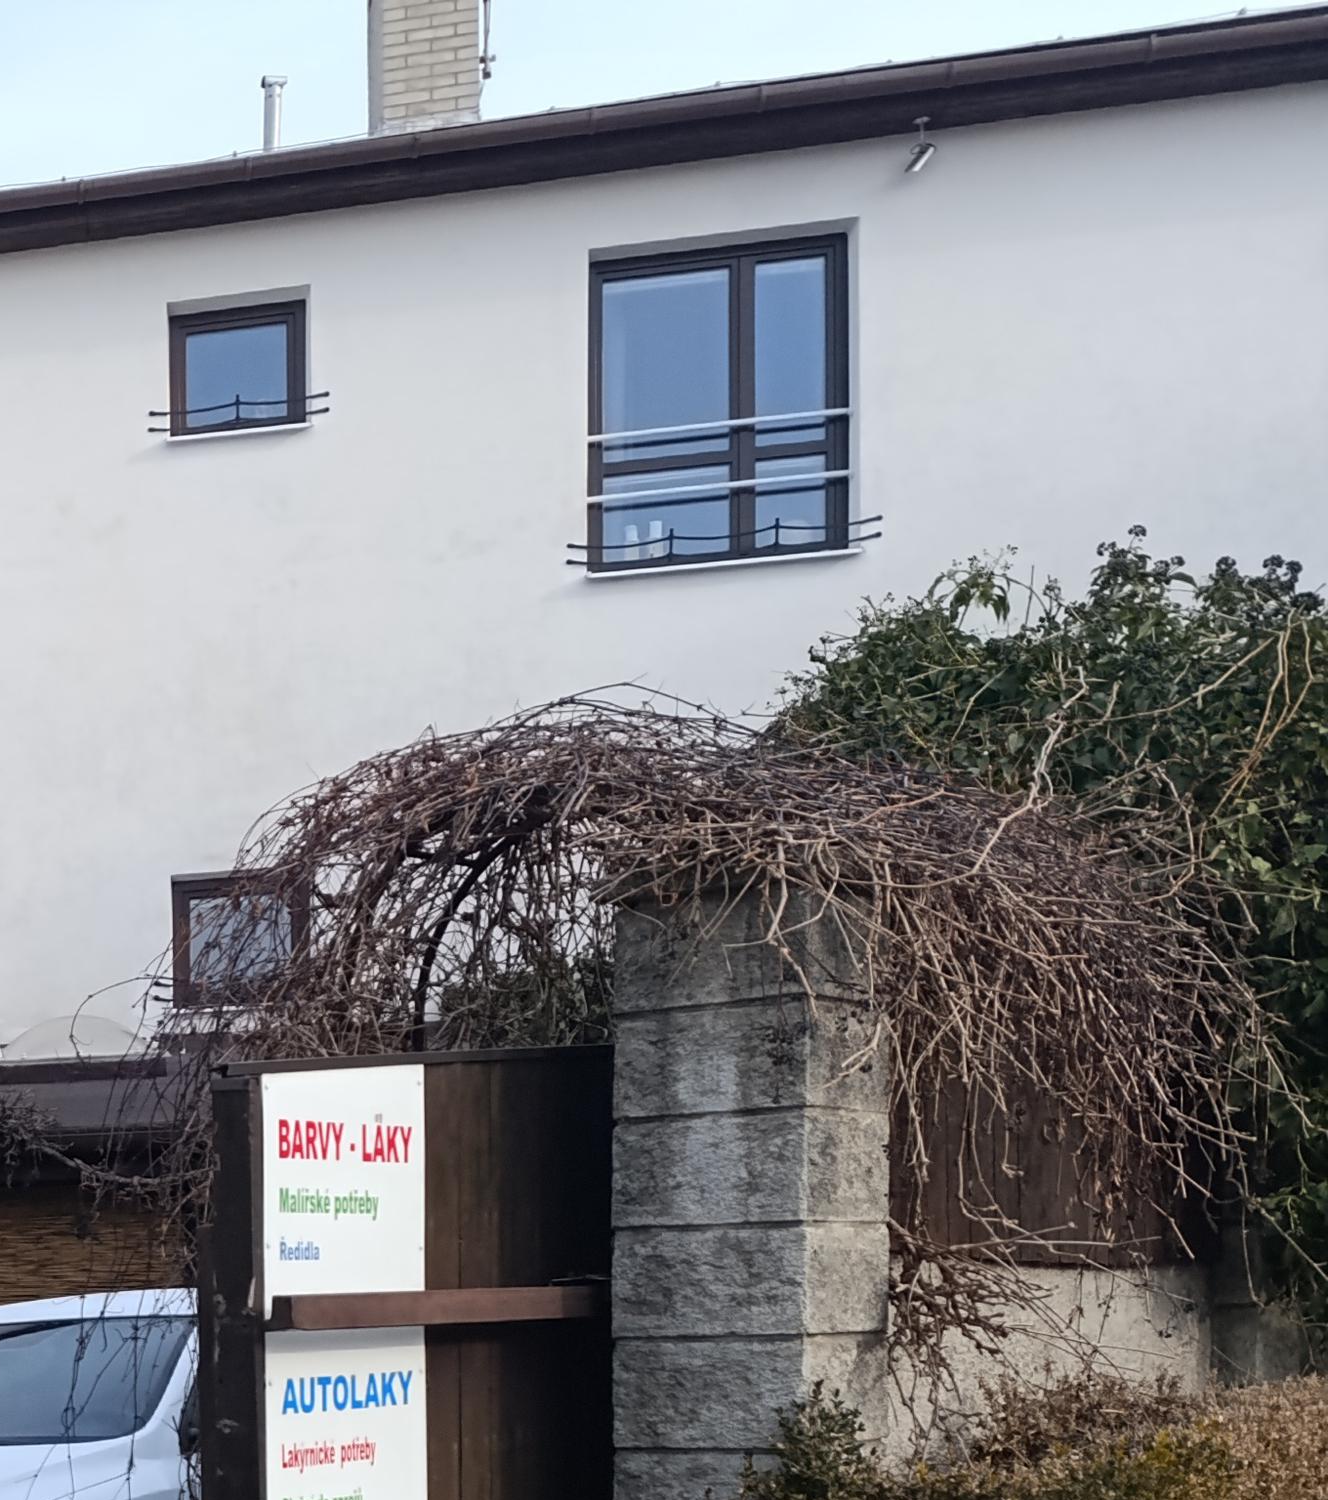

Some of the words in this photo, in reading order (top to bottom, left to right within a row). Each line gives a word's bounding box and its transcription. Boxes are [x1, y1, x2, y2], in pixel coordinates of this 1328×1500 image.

[278, 1119, 344, 1161] BARVY
[362, 1124, 413, 1163] LAKY
[279, 1187, 331, 1214] Malířské
[334, 1190, 379, 1221] potřeby
[279, 1236, 320, 1261] Ředidla
[282, 1370, 413, 1415] AUTOLAKY
[340, 1436, 377, 1469] potřeby
